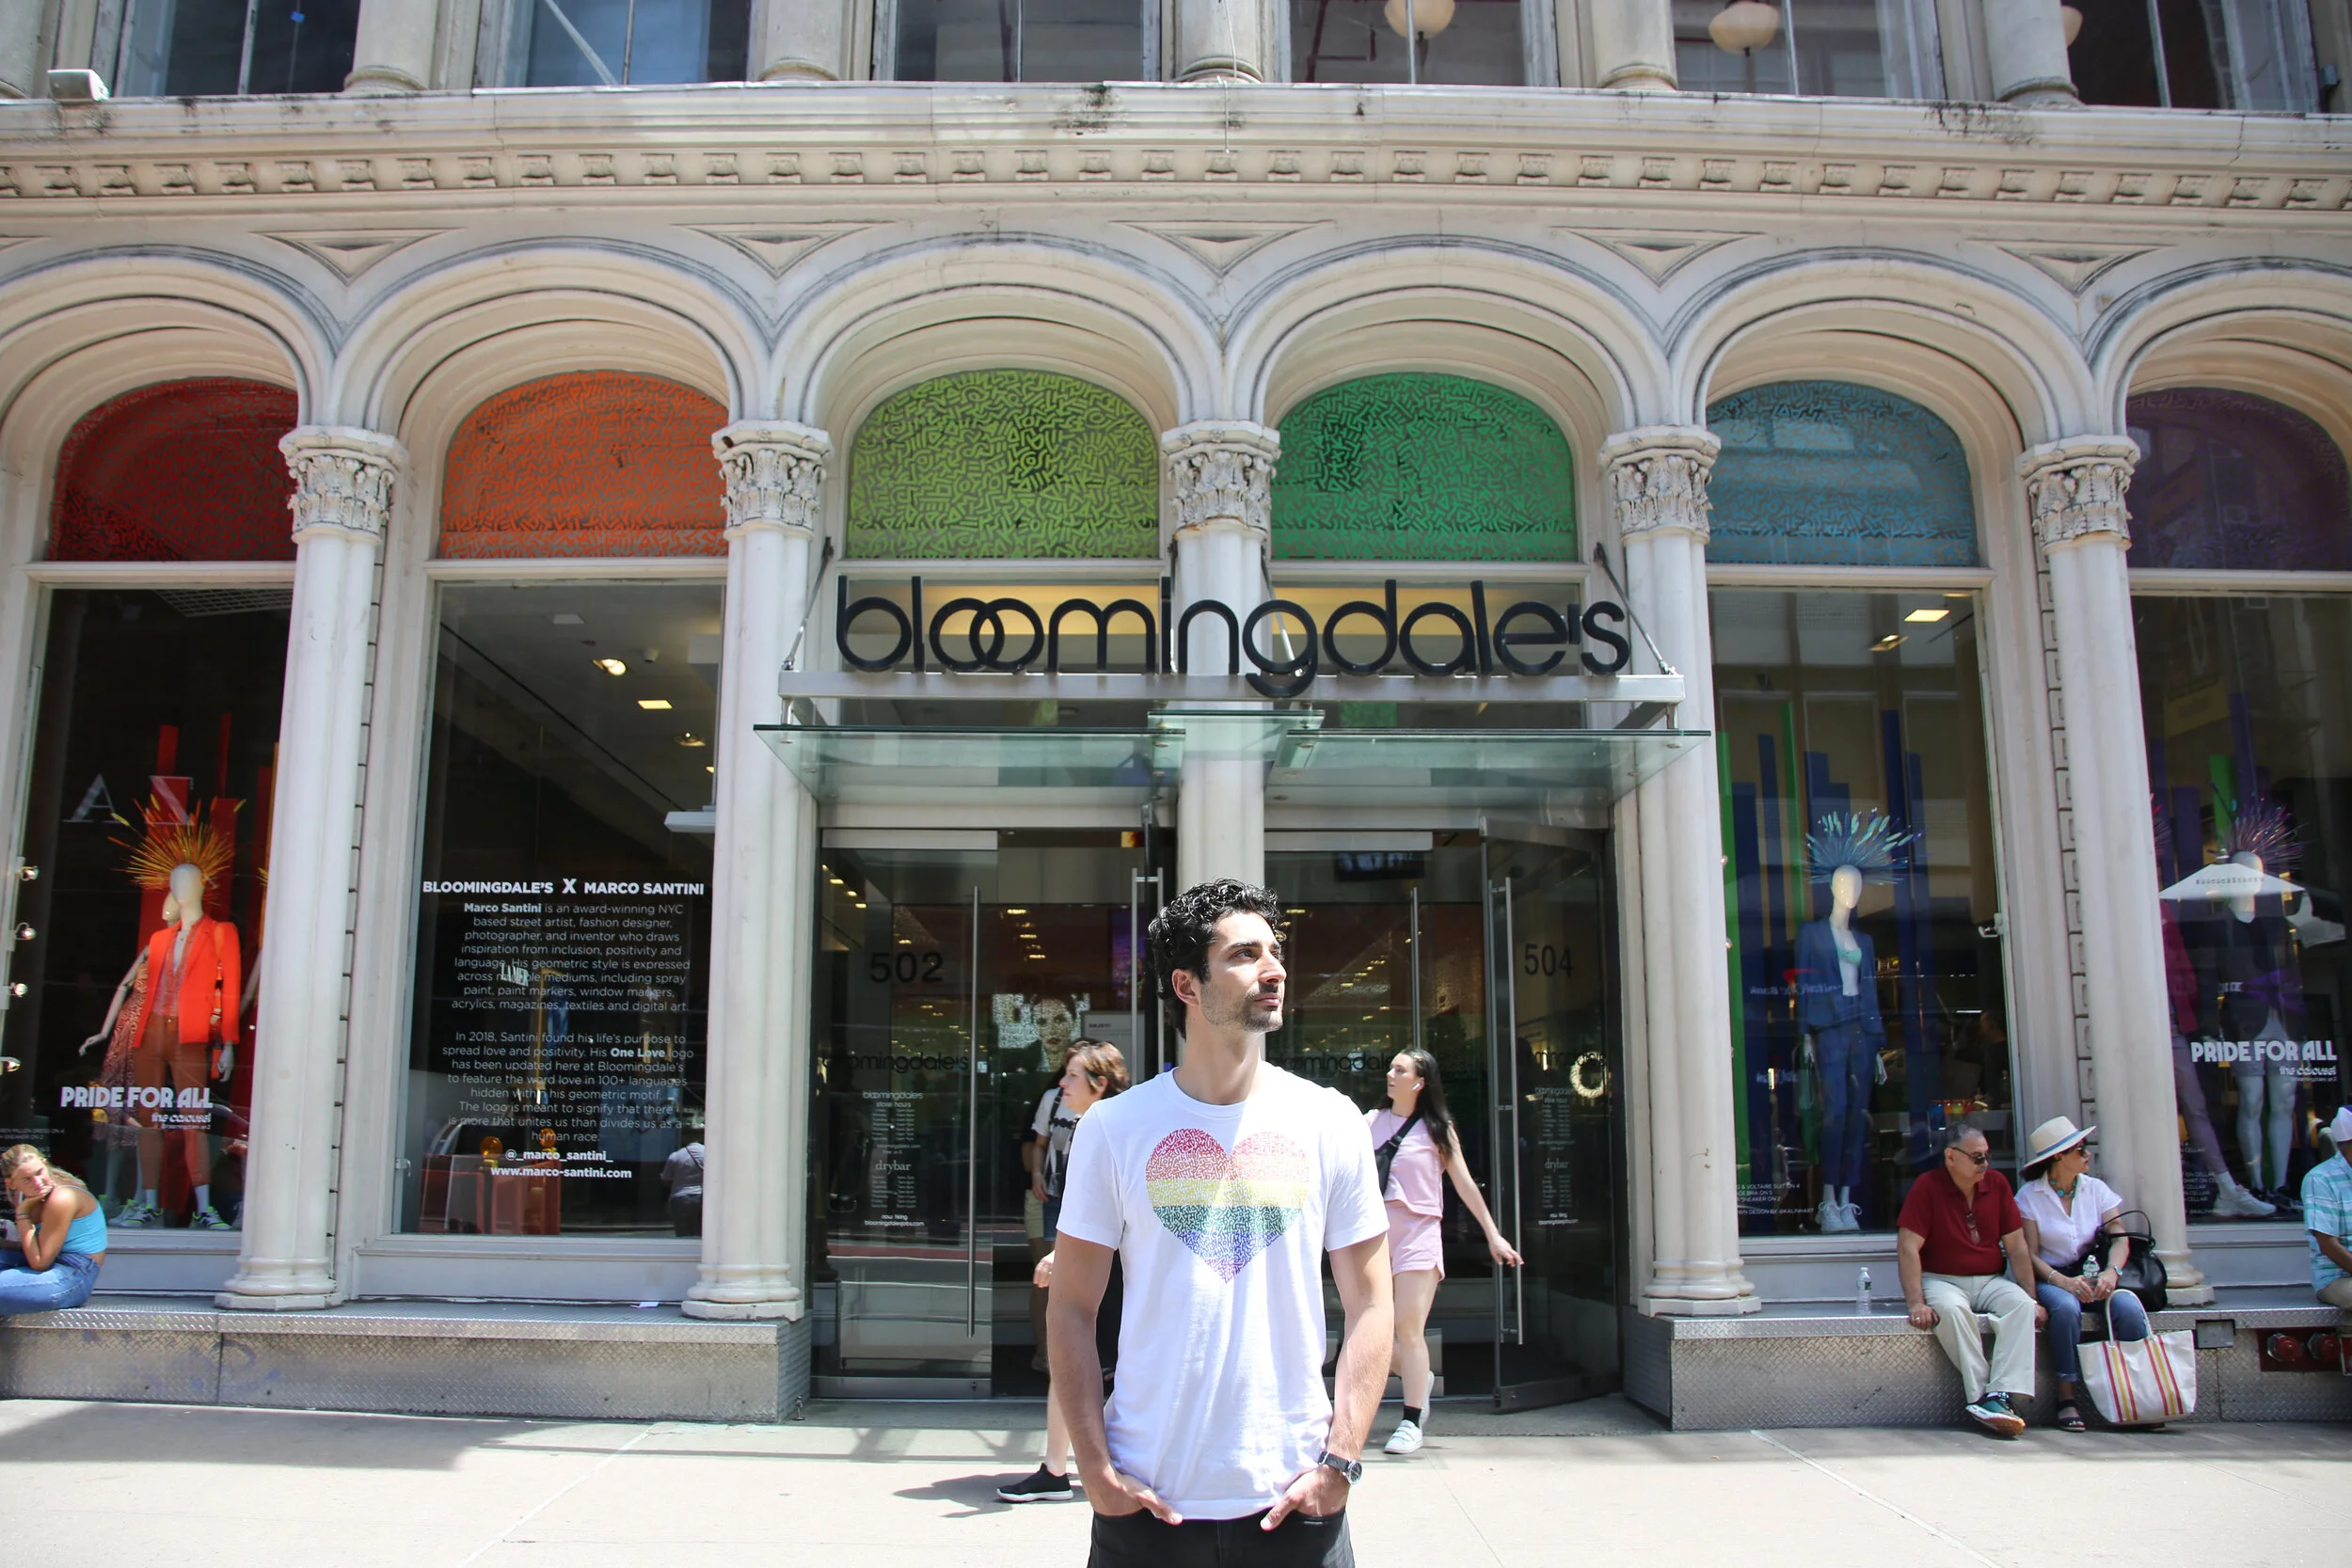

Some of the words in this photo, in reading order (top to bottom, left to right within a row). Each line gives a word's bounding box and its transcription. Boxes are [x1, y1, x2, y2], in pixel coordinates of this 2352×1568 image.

[422, 881, 553, 894] BLOOMINGDALE'S
[562, 879, 577, 894] X
[584, 882, 639, 895] MARCO
[643, 883, 705, 895] SANTINI
[464, 903, 499, 912] Marco
[501, 903, 542, 913] Santini
[545, 904, 553, 913] is
[573, 904, 656, 916] award-winning
[659, 904, 684, 914] NYC
[473, 917, 506, 927] based
[510, 918, 541, 927] street
[580, 918, 619, 927] fashion
[465, 931, 543, 942] photographer,
[546, 931, 566, 941] and
[570, 932, 614, 941] inventor
[619, 932, 643, 941] who
[646, 933, 679, 942] draws
[461, 944, 518, 955] inspiration
[522, 945, 548, 954] from
[606, 945, 657, 957] positivity
[660, 946, 682, 955] and
[512, 958, 529, 967] His
[532, 958, 589, 969] geometric
[592, 959, 619, 970] style
[622, 959, 630, 969] is
[633, 959, 691, 970] expressed
[1524, 943, 1574, 977] 504
[870, 952, 944, 983] 502
[457, 973, 493, 981] across
[496, 972, 541, 982] mple
[601, 974, 652, 984] including
[656, 974, 686, 985] spray
[498, 986, 525, 995] paint
[580, 987, 624, 996] window
[564, 1001, 604, 1010] textiles
[608, 1001, 628, 1010] and
[632, 1001, 667, 1012] digital
[455, 1032, 466, 1041] In
[501, 1032, 538, 1042] Santini
[542, 1033, 574, 1042] found
[578, 1033, 593, 1043] his
[596, 1033, 621, 1043] life's
[674, 1035, 686, 1044] to
[442, 1045, 480, 1056] spread
[484, 1046, 506, 1054] love
[509, 1047, 530, 1055] and
[590, 1048, 607, 1057] His
[610, 1048, 634, 1057] One
[637, 1048, 666, 1057] Love
[2190, 1041, 2251, 1062] PRIDE
[2253, 1040, 2299, 1062] FOR
[2302, 1040, 2338, 1061] ALL
[452, 1059, 470, 1069] has
[474, 1060, 501, 1069] been
[505, 1060, 551, 1070] updated
[555, 1061, 580, 1070] here
[583, 1062, 595, 1070] at
[597, 1061, 684, 1073] Bloomingdale's
[448, 1074, 459, 1083] to
[463, 1073, 502, 1084] feature
[505, 1074, 523, 1084] the
[527, 1075, 555, 1085] word
[559, 1075, 581, 1085] love
[585, 1075, 595, 1085] in
[599, 1075, 625, 1085] 100+
[628, 1076, 688, 1087] languages
[60, 1086, 124, 1108] PRIDE
[127, 1086, 174, 1108] FOR
[177, 1086, 214, 1108] ALL
[470, 1087, 509, 1098] hidden
[513, 1088, 548, 1099] withn
[549, 1089, 565, 1099] his
[568, 1090, 627, 1101] geometric
[459, 1101, 480, 1111] The
[483, 1101, 508, 1113] logo
[511, 1102, 519, 1112] is
[523, 1102, 558, 1113] meant
[562, 1104, 574, 1113] to
[577, 1104, 615, 1115] signify
[617, 1104, 640, 1114] that
[644, 1105, 673, 1115] there
[492, 1117, 515, 1126] that
[518, 1117, 551, 1127] unites
[571, 1118, 596, 1127] than
[600, 1118, 640, 1128] divides
[532, 1131, 570, 1141] human
[505, 1148, 613, 1163] @_marco_santini_
[491, 1167, 632, 1179] www.marco-santini.com
[875, 1160, 912, 1174] drybar
